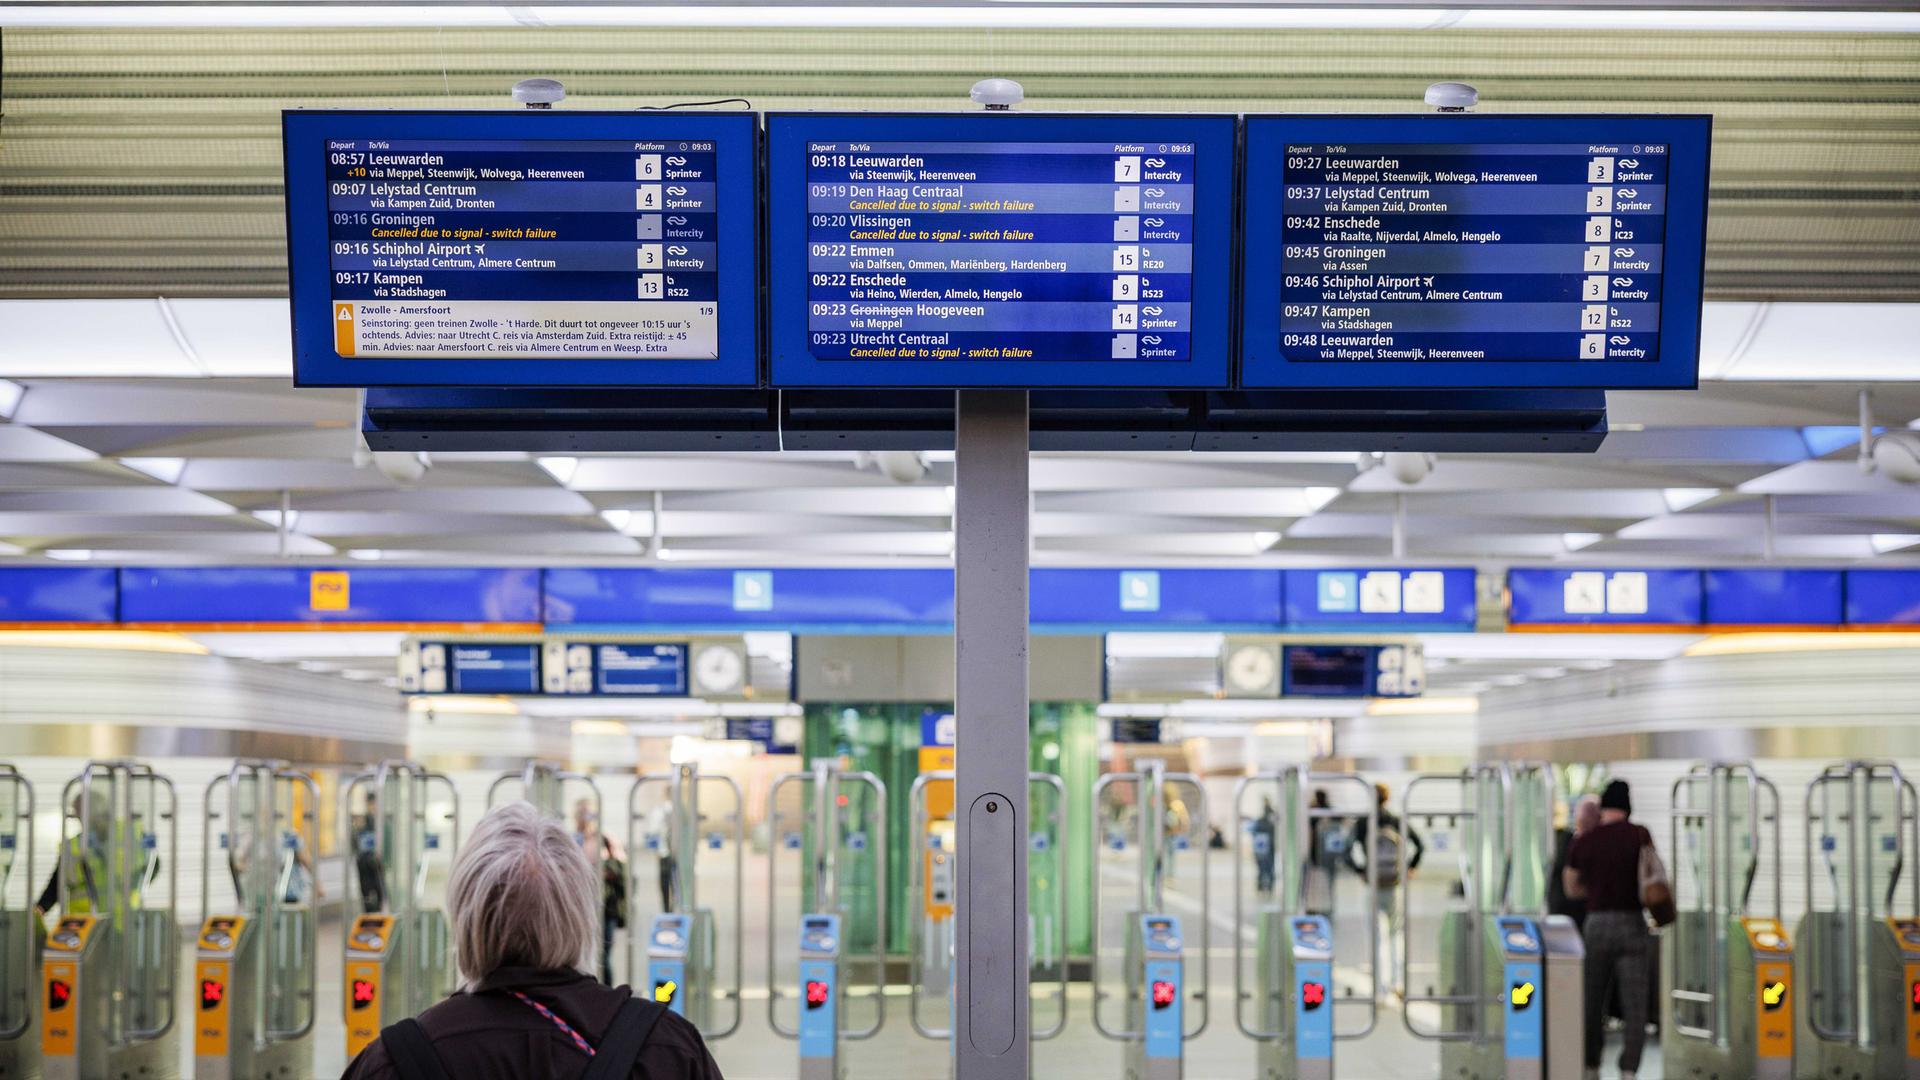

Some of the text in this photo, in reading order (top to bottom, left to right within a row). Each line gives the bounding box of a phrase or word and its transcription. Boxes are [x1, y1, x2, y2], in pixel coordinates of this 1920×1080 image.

[331, 141, 355, 150] Depart
[331, 152, 443, 165] 08:57 Leeuwarden
[812, 155, 923, 167] 09:18 Leeuwarden
[1288, 156, 1399, 169] 09:27 Leeuwarden
[645, 163, 652, 174] 6
[1124, 165, 1131, 176] 7
[348, 168, 584, 181] +10 via Meppel, Steenwijk, Wolvega, Heerenveen
[666, 169, 702, 180] Sprinter
[849, 170, 976, 182] via Steenwijk, Heerenveen
[1145, 171, 1181, 182] Intercity
[1618, 172, 1653, 182] Sprinter
[333, 182, 476, 198] 09:07 Lelystad Centrum
[813, 185, 963, 199] 09:19 Den Haag Centraal
[1288, 186, 1429, 201] 09:37 Lelystad Centrum
[370, 198, 495, 210] via Kampen Zuid, Dronten
[666, 199, 702, 209] Sprinter
[1144, 200, 1181, 211] Intercity
[1596, 196, 1603, 207] 3
[1616, 201, 1652, 211] Sprinter
[334, 213, 435, 226] 09:16 Groningen
[813, 214, 911, 229] 09:20 Vlissingen
[1287, 216, 1380, 229] 09:42 Enschede
[372, 227, 418, 237] Cancelled
[420, 228, 438, 237] due
[442, 229, 451, 238] to
[454, 228, 483, 240] signal
[492, 228, 522, 238] switch
[525, 228, 556, 238] failure
[667, 228, 703, 239] Intercity
[850, 229, 896, 239] Cancelled
[898, 230, 916, 239] due
[919, 231, 929, 239] to
[931, 230, 960, 242] signal
[969, 230, 1000, 240] switch
[1003, 230, 1034, 240] failure
[1144, 230, 1180, 240] Intercity
[1594, 225, 1602, 236] 8
[1615, 231, 1633, 240] IC23
[1324, 231, 1500, 243] via Raalte, Nijverdal, Almelo, Hengelo
[335, 242, 471, 257] 09:16 Schiphol Airport
[813, 245, 894, 256] 09:22 Emmen
[1286, 246, 1386, 260] 09:45 Groningen
[373, 256, 556, 269] via Lelystad Centrum, Almere Centrum
[646, 252, 653, 264] 3
[667, 258, 704, 269] Intercity
[1120, 254, 1133, 265] 15
[1594, 255, 1600, 266] 7
[850, 259, 1066, 271] via Dalfsen, Ommen, Mariënberg, Hardenberg
[1143, 260, 1164, 269] RE20
[1323, 261, 1367, 270] via Assen
[1614, 260, 1650, 271] Intercity
[336, 272, 422, 286] 09:17 Kampen
[813, 273, 906, 286] 09:22 Enschede
[1285, 275, 1420, 289] 09:46 Schiphol Airport
[374, 286, 446, 298] via Stadshagen
[644, 282, 657, 293] 13
[1592, 284, 1599, 295] 3
[850, 288, 1022, 301] via Heino, Wierden, Almelo, Hengelo
[1612, 290, 1648, 300] Intercity
[361, 305, 391, 314] Zwolle
[400, 306, 451, 314] Amersfoort
[700, 307, 713, 315] 1/9
[813, 304, 984, 317] 09:23 Groningen Hoogeveen
[1285, 305, 1370, 318] 09:47 Kampen
[1119, 313, 1132, 324] 14
[1142, 318, 1177, 329] Sprinter
[1588, 313, 1600, 324] 12
[1610, 319, 1631, 327] RS22
[361, 319, 411, 329] Seinstoring:
[414, 321, 434, 329] geen
[437, 319, 467, 327] treinen
[470, 319, 498, 328] Zwolle
[515, 320, 542, 328] Harde.
[544, 320, 556, 328] Dit
[559, 320, 582, 328] duurt
[600, 322, 638, 330] ongeveer
[642, 320, 665, 328] 10:15
[813, 332, 948, 345] 09:23 Utrecht Centraal
[1284, 333, 1393, 346] 09:48 Leeuwarden
[1141, 348, 1176, 358] Sprinter
[1589, 342, 1596, 354] 6
[1609, 348, 1645, 358] Intercity
